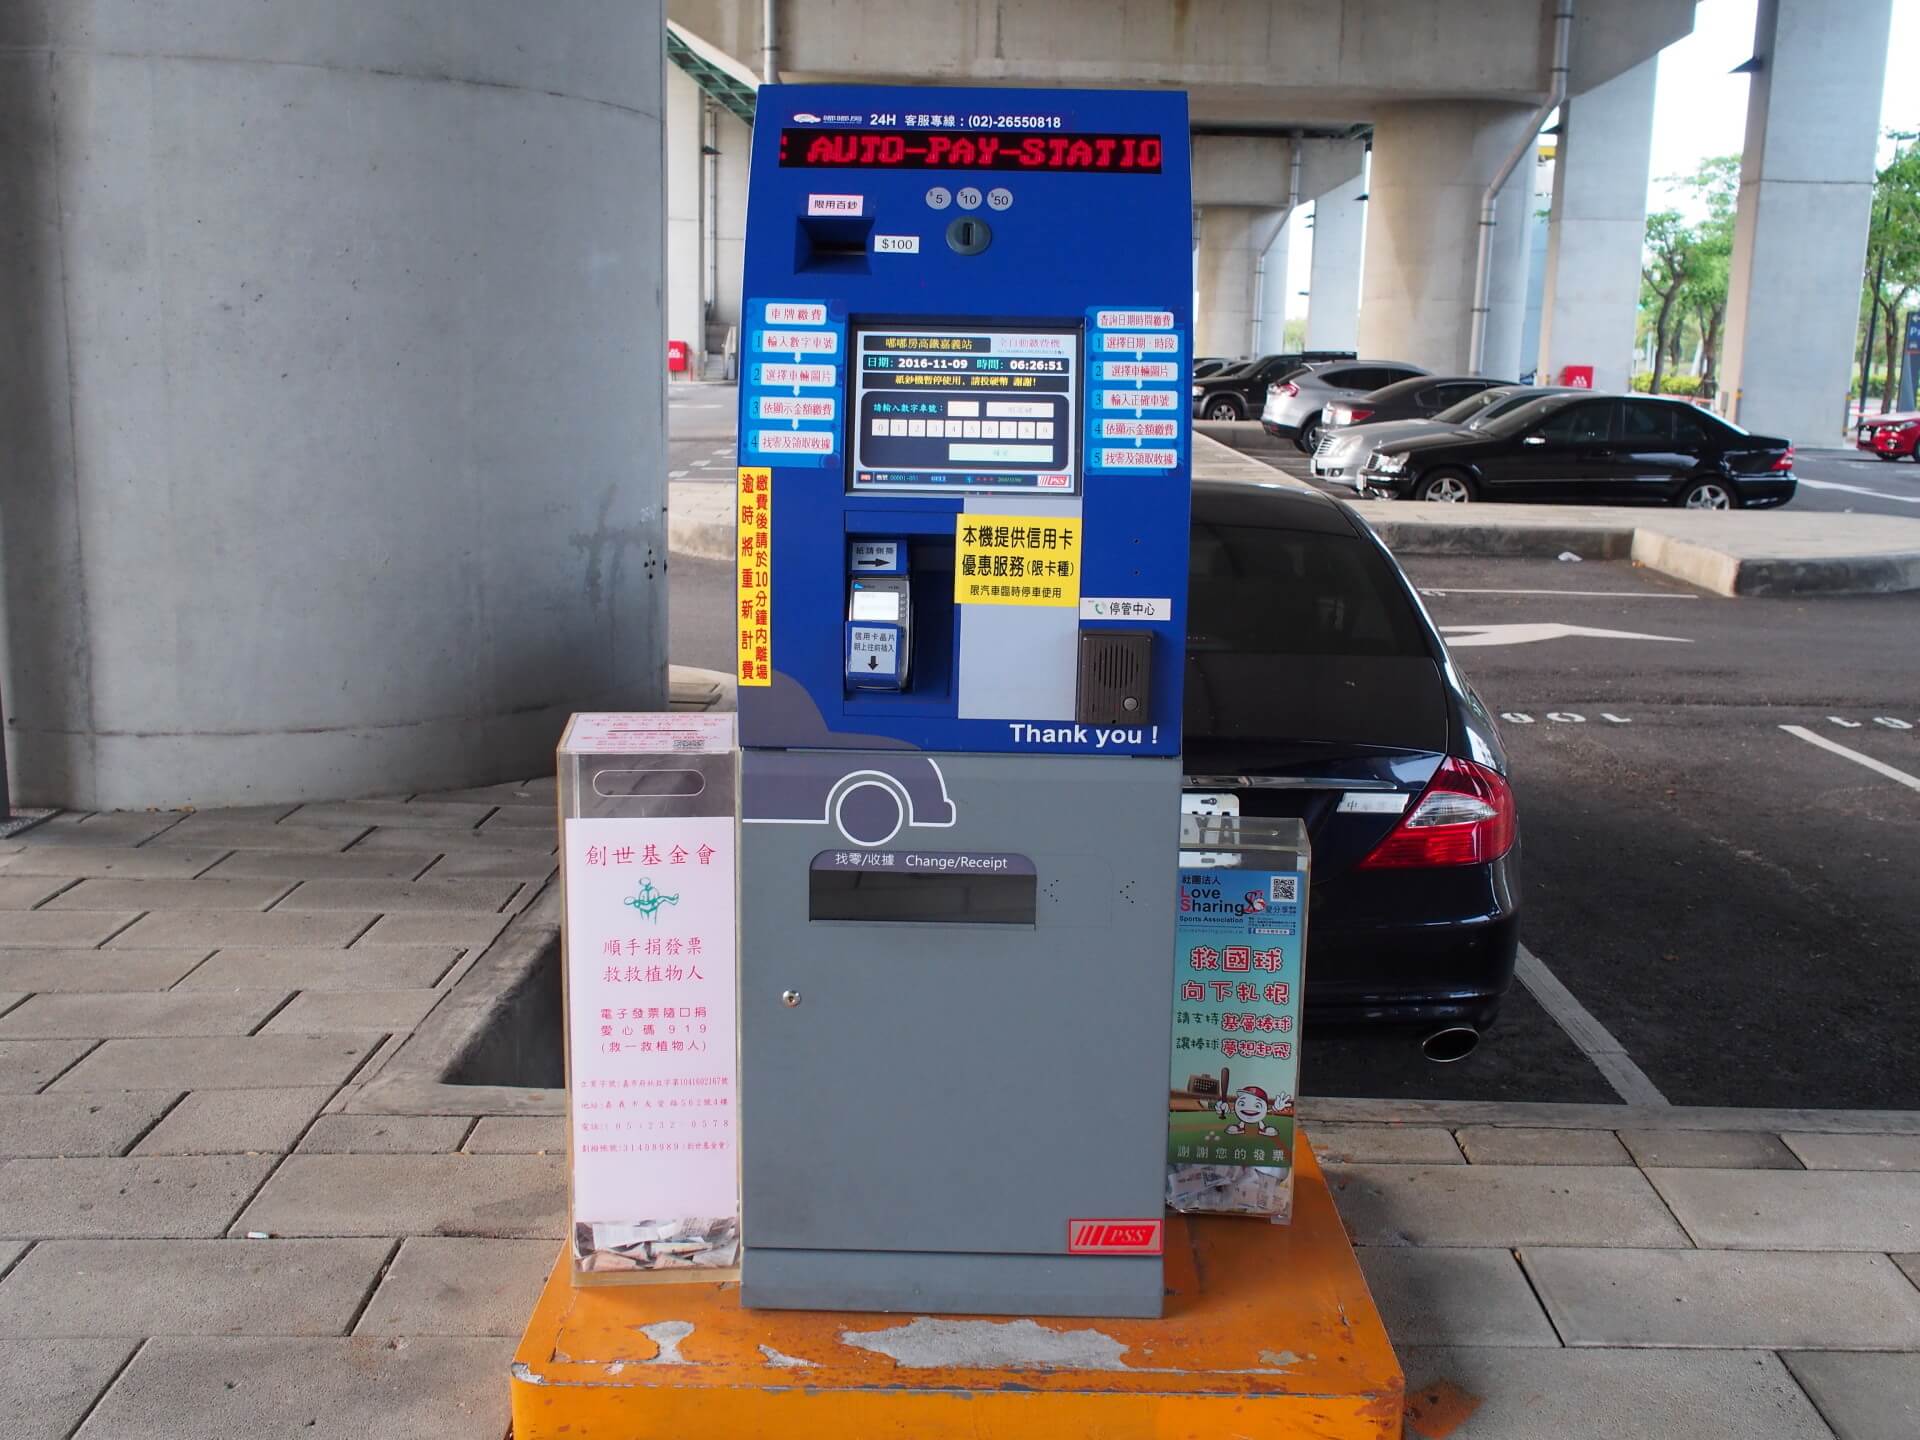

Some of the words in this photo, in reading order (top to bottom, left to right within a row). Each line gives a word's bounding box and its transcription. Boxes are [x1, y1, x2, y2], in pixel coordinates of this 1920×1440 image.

[870, 114, 896, 126] 24H
[814, 199, 858, 210] 限用百鈔
[881, 238, 913, 250] $100
[770, 308, 823, 321] 車牌繳費
[898, 358, 968, 369] 2016-11-09
[1009, 360, 1063, 371] 06:26:51
[962, 524, 1073, 550] 本機提供信用卡
[741, 473, 754, 680] 逾時將重新計費
[755, 474, 769, 680] 繳費後請於10分鐘內離場
[970, 584, 1062, 599] 限汽車臨時停車使用
[1109, 602, 1155, 616] 停管中心
[1009, 723, 1087, 744] Thank
[1095, 728, 1142, 748] you
[585, 843, 717, 866] 創世基金會
[834, 852, 894, 866] 找零/收據
[905, 854, 1008, 871] Change/Receipt
[1180, 886, 1221, 899] Love
[1180, 899, 1245, 916] Sharing
[603, 936, 704, 956] 順手捐發票
[1190, 945, 1284, 973] 救國球
[603, 964, 704, 982] 救救植物人
[600, 1006, 707, 1020] 電子發票隨口捐
[1177, 1144, 1284, 1162] 謝謝您的發票
[1110, 1229, 1146, 1242] PSS
